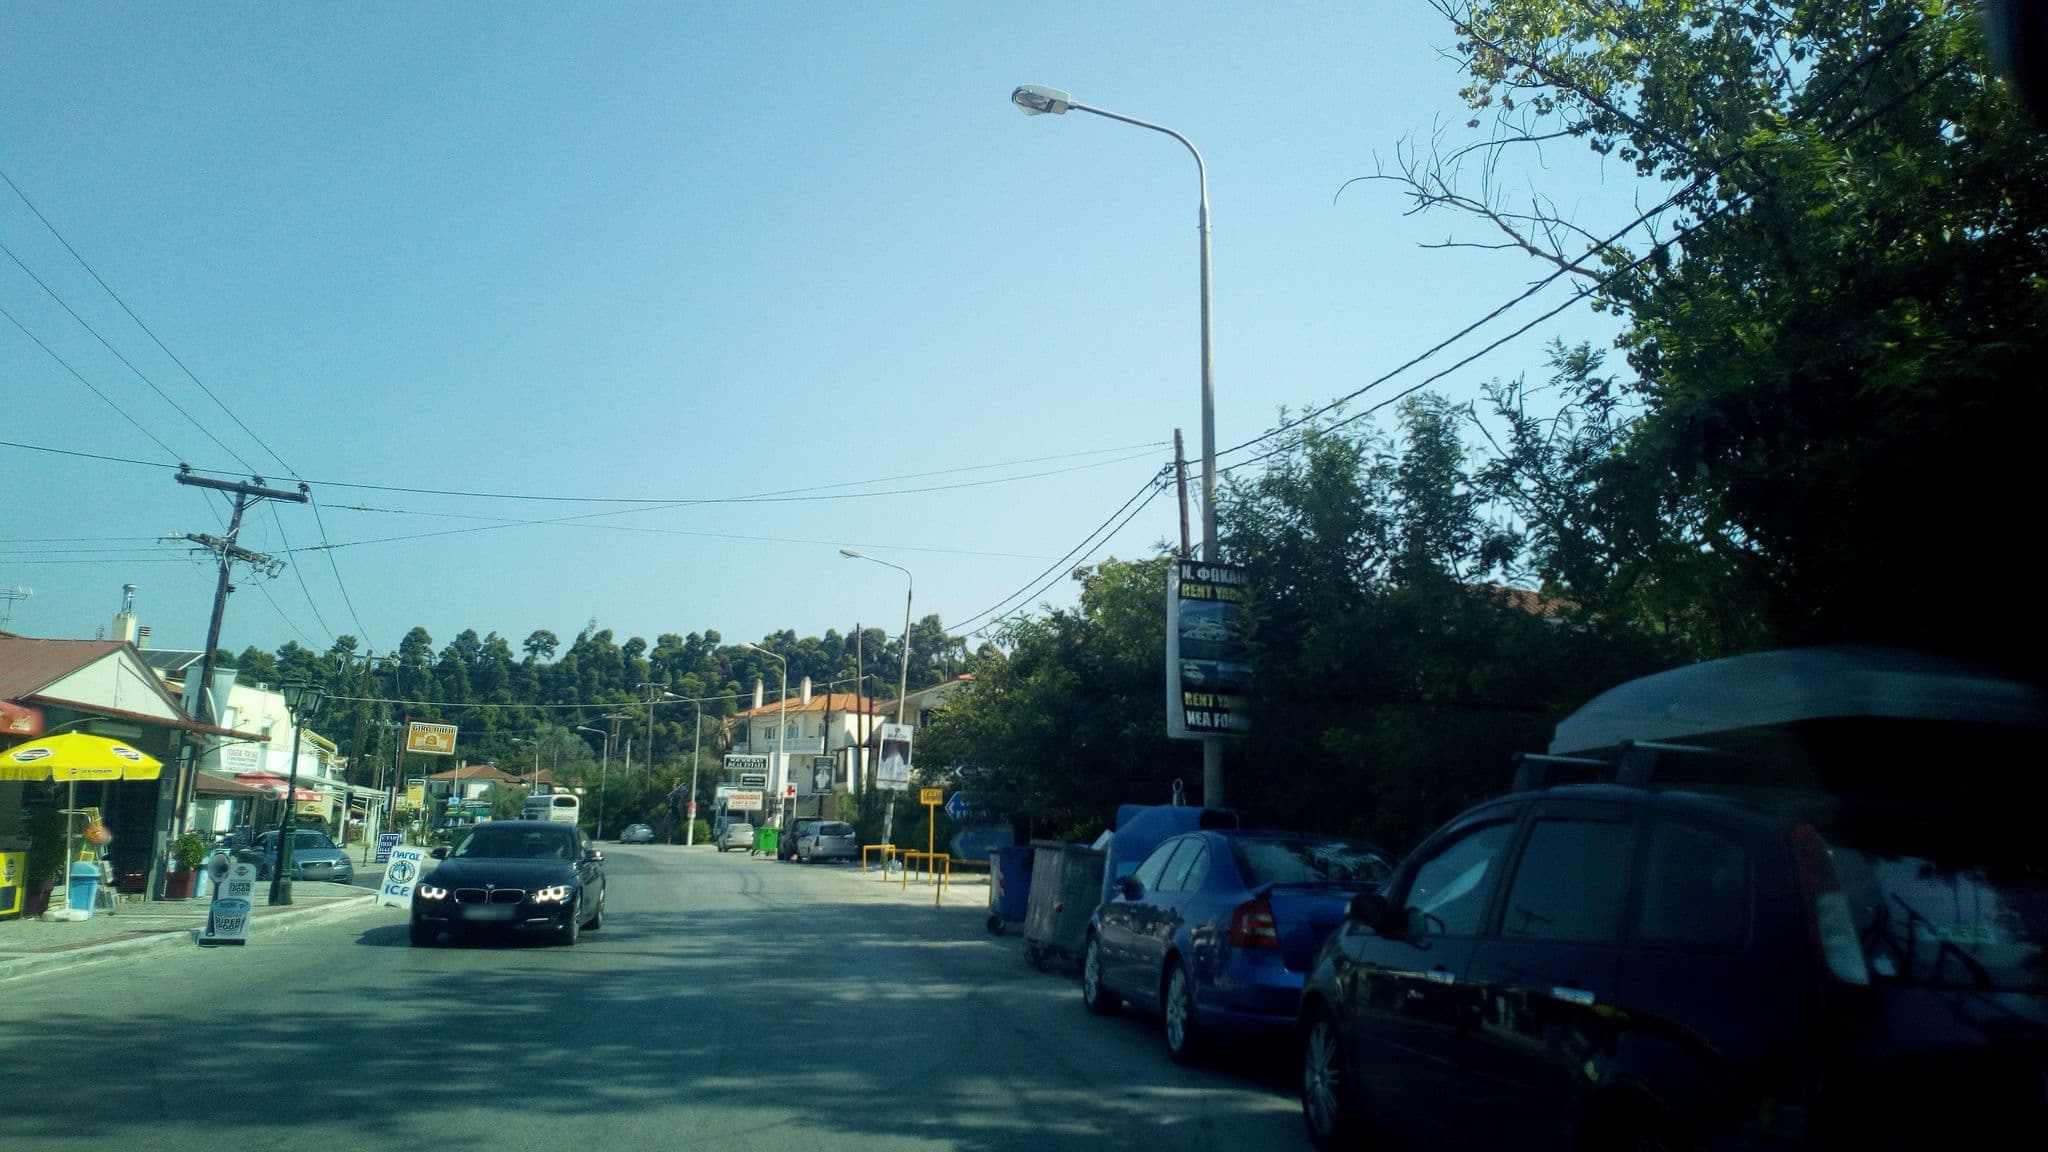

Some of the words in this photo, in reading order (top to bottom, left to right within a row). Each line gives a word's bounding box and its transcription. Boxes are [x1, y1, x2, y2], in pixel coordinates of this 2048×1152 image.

[1181, 583, 1212, 599] RENT
[1184, 691, 1214, 708] RENT
[1216, 694, 1232, 709] YA
[1186, 710, 1211, 727] NEA
[1213, 712, 1232, 728] FO
[384, 884, 409, 897] ICE
